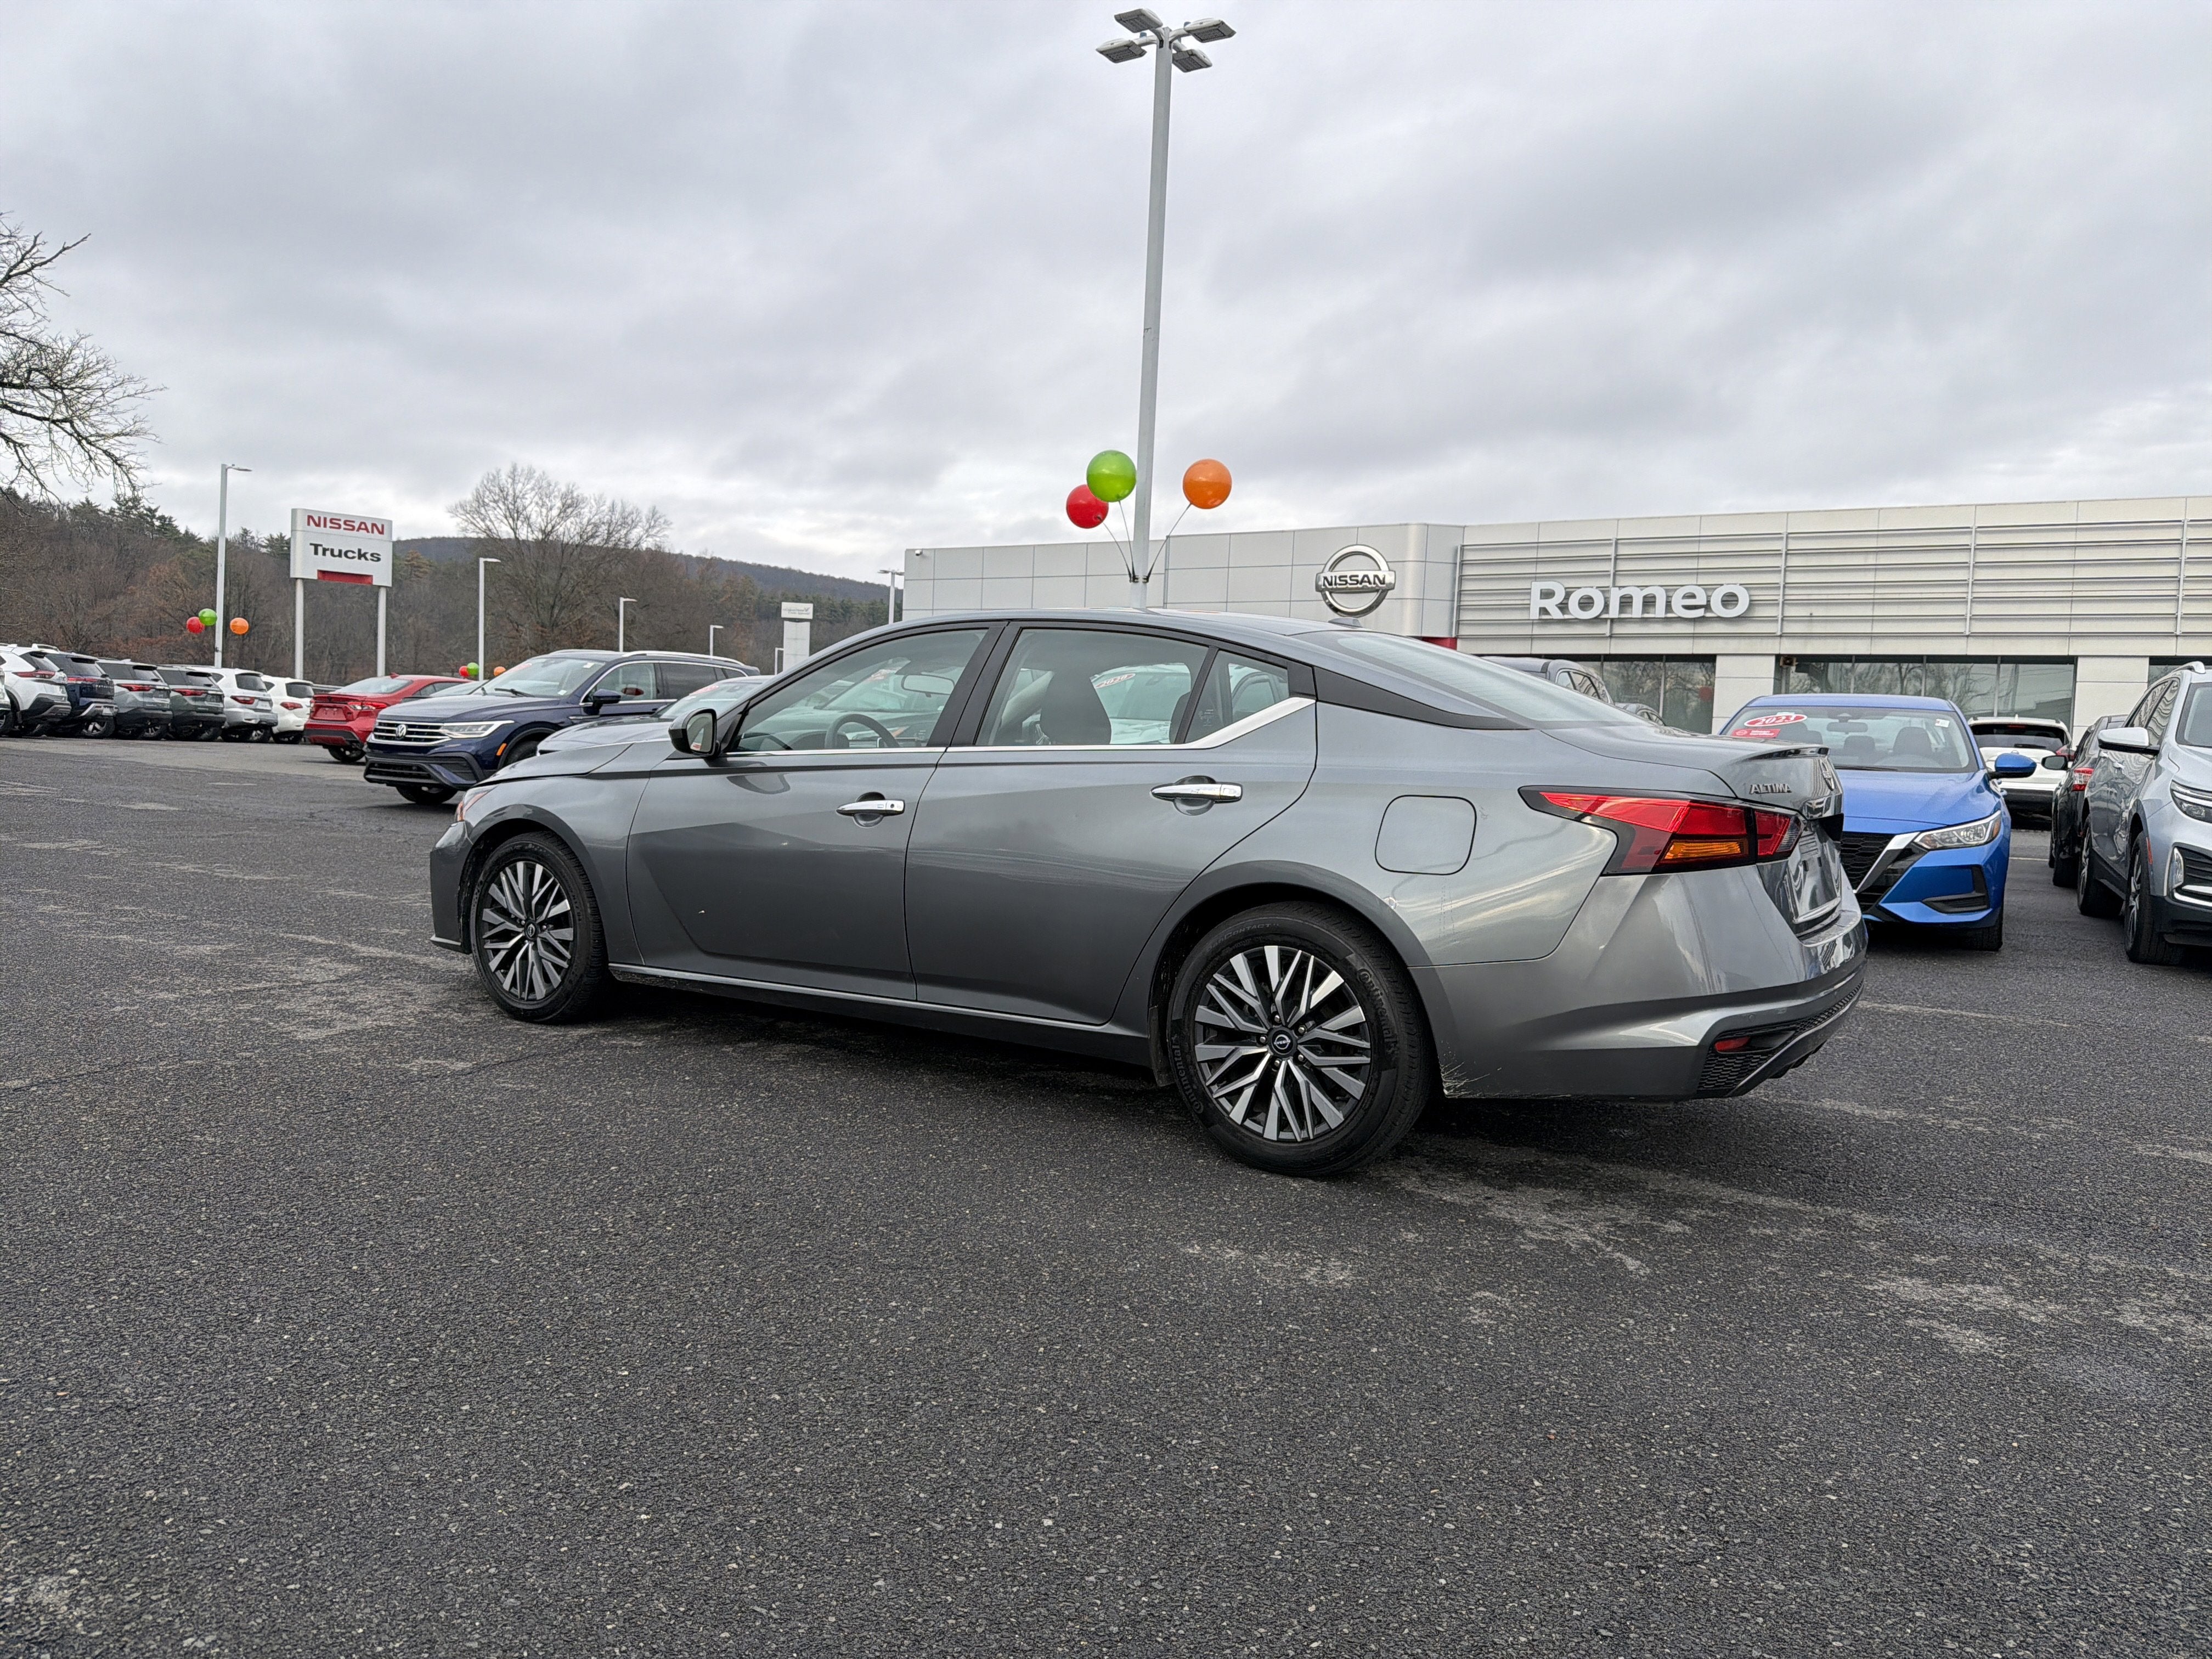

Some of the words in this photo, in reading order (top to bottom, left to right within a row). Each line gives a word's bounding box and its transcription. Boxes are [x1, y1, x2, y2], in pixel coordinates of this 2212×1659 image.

[307, 515, 385, 535] NISSAN
[309, 543, 381, 562] Trucks
[1322, 574, 1386, 588] NISSAN
[1530, 580, 1750, 619] Romeo
[1754, 715, 1796, 725] 2023
[1750, 783, 1791, 794] ALTIMA
[1172, 1045, 1204, 1114] Continental
